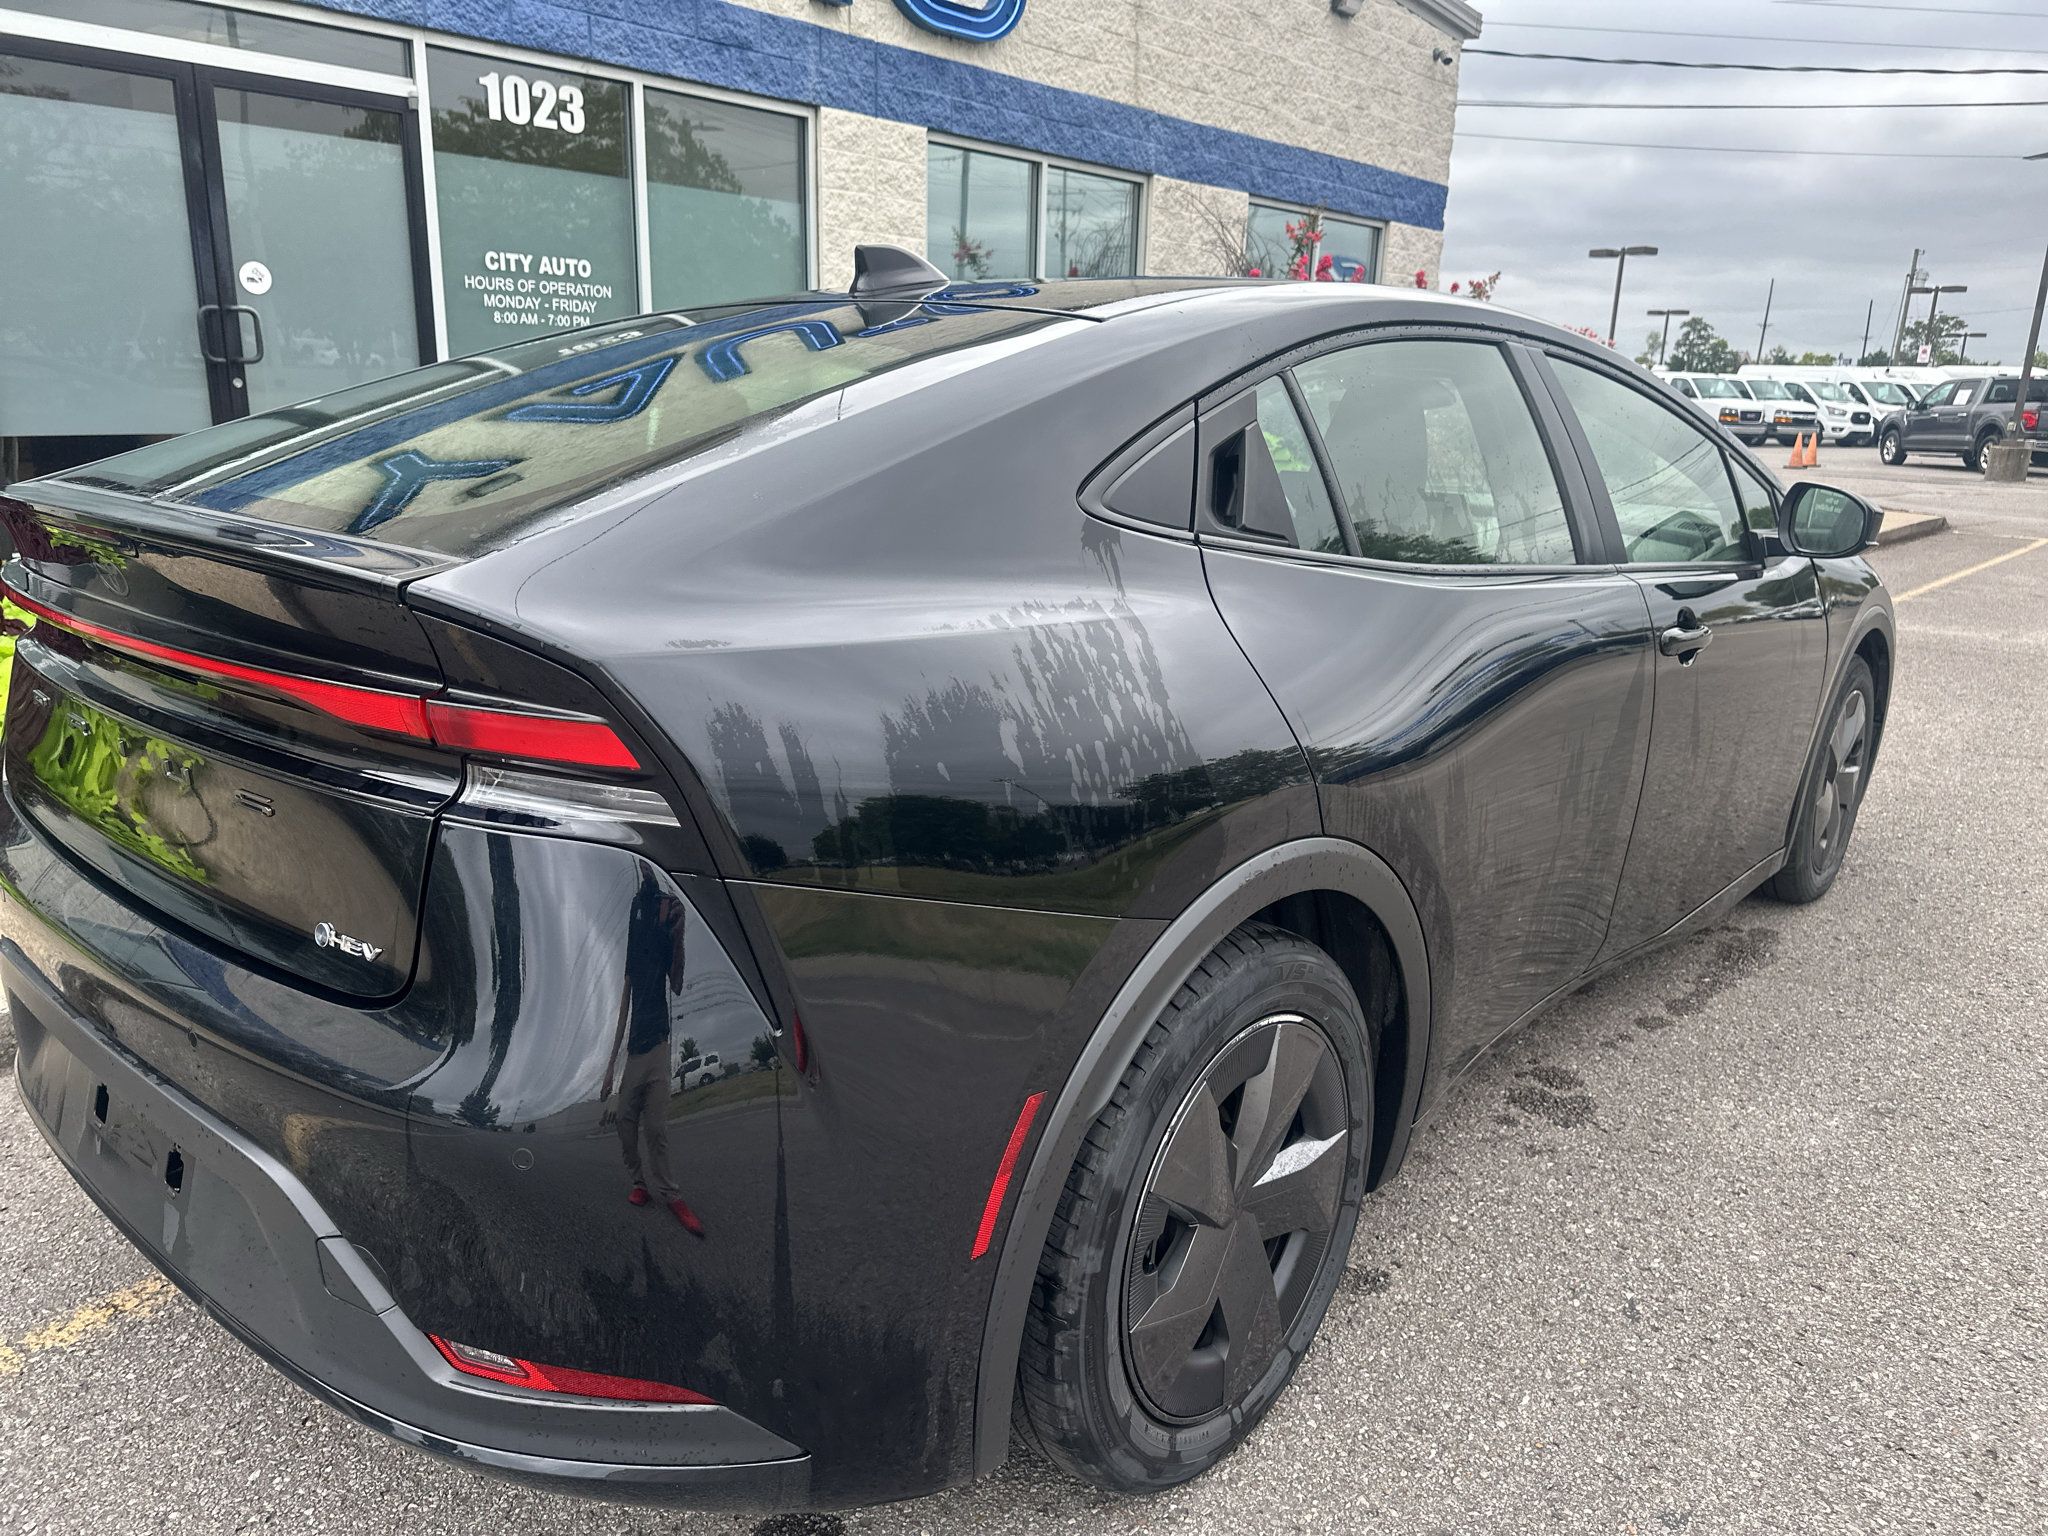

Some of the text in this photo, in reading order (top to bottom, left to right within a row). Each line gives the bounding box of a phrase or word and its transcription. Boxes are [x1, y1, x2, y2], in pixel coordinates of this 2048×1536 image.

[478, 71, 586, 135] 1023
[484, 250, 592, 278] CITY AUTO
[464, 274, 612, 299] HOURS OF OPERATION
[483, 293, 541, 310] MONDAY
[552, 298, 597, 313] FRIDAY
[493, 311, 518, 325] 8:00
[520, 312, 538, 325] AM
[548, 313, 571, 327] 7:00
[572, 315, 590, 328] PM
